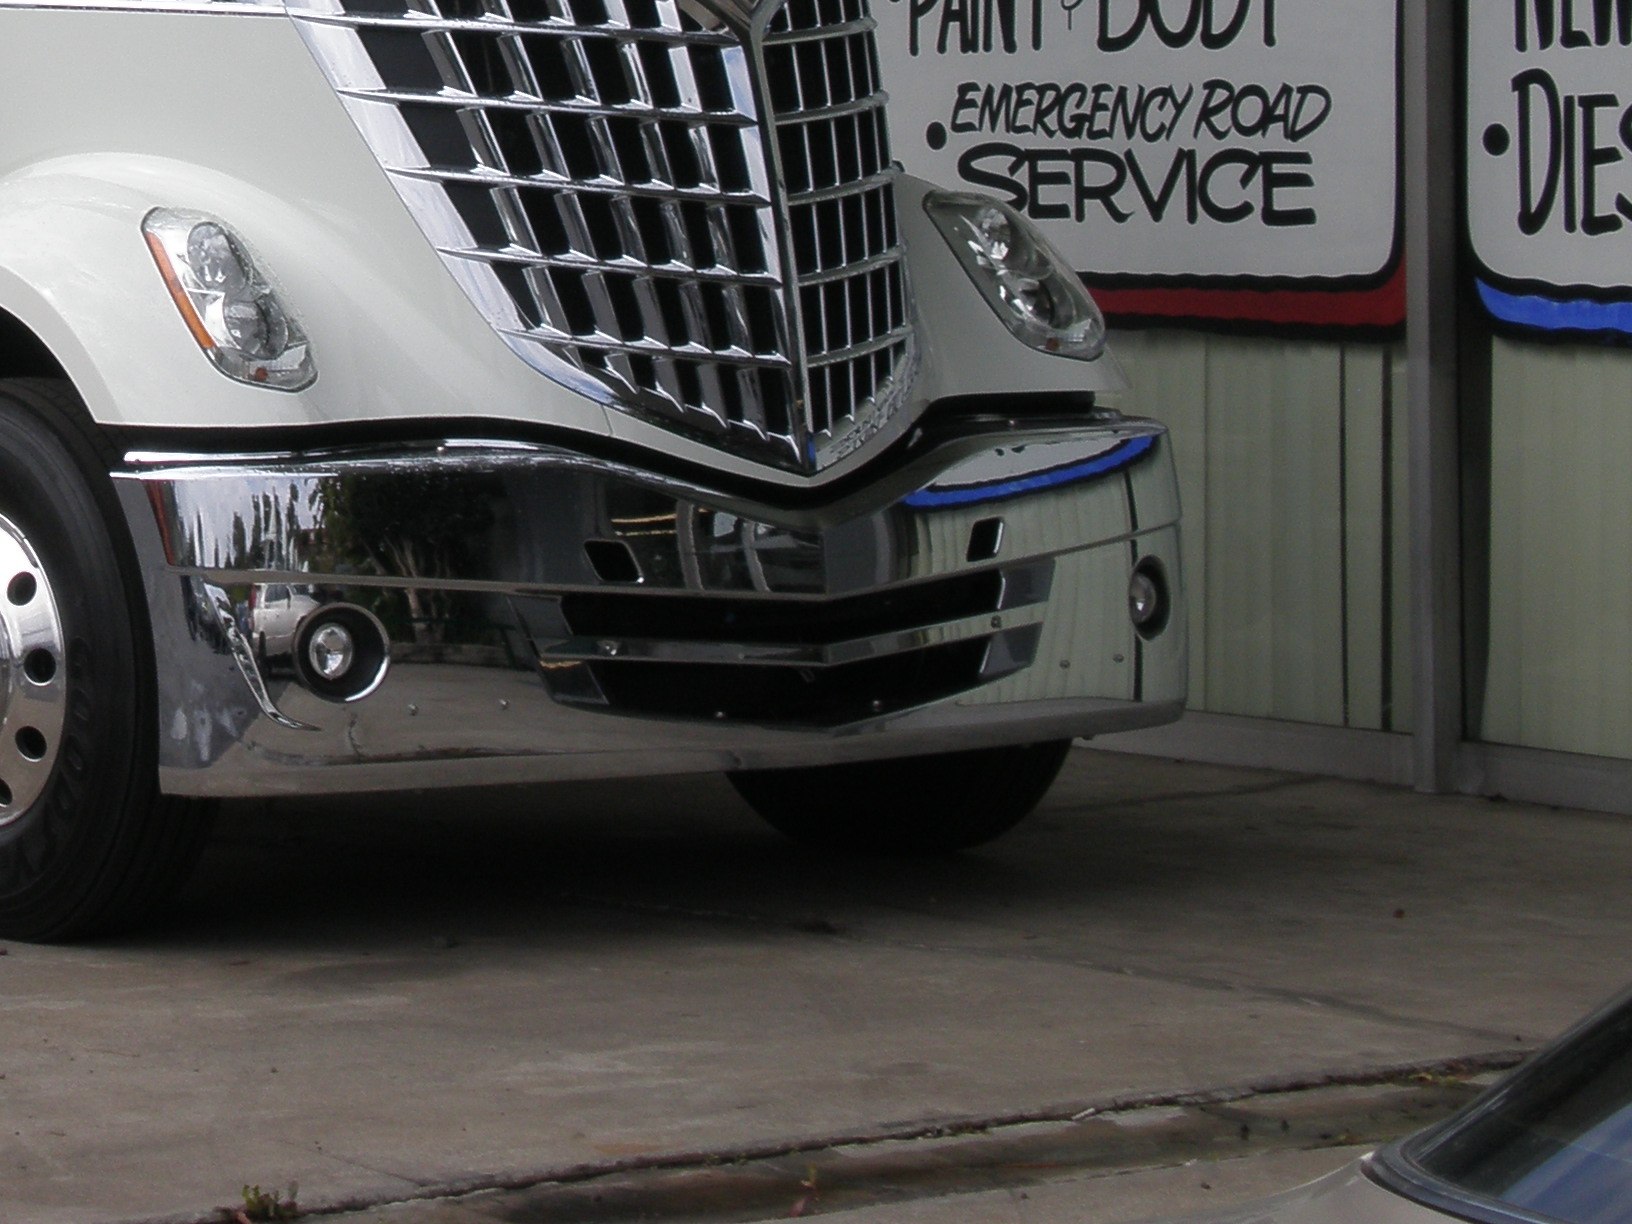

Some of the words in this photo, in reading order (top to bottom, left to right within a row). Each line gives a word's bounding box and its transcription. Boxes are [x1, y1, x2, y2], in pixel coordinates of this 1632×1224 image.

[949, 80, 1194, 143] EMERGENCY
[1192, 78, 1333, 143] ROAD
[957, 141, 1318, 227] SERVICE
